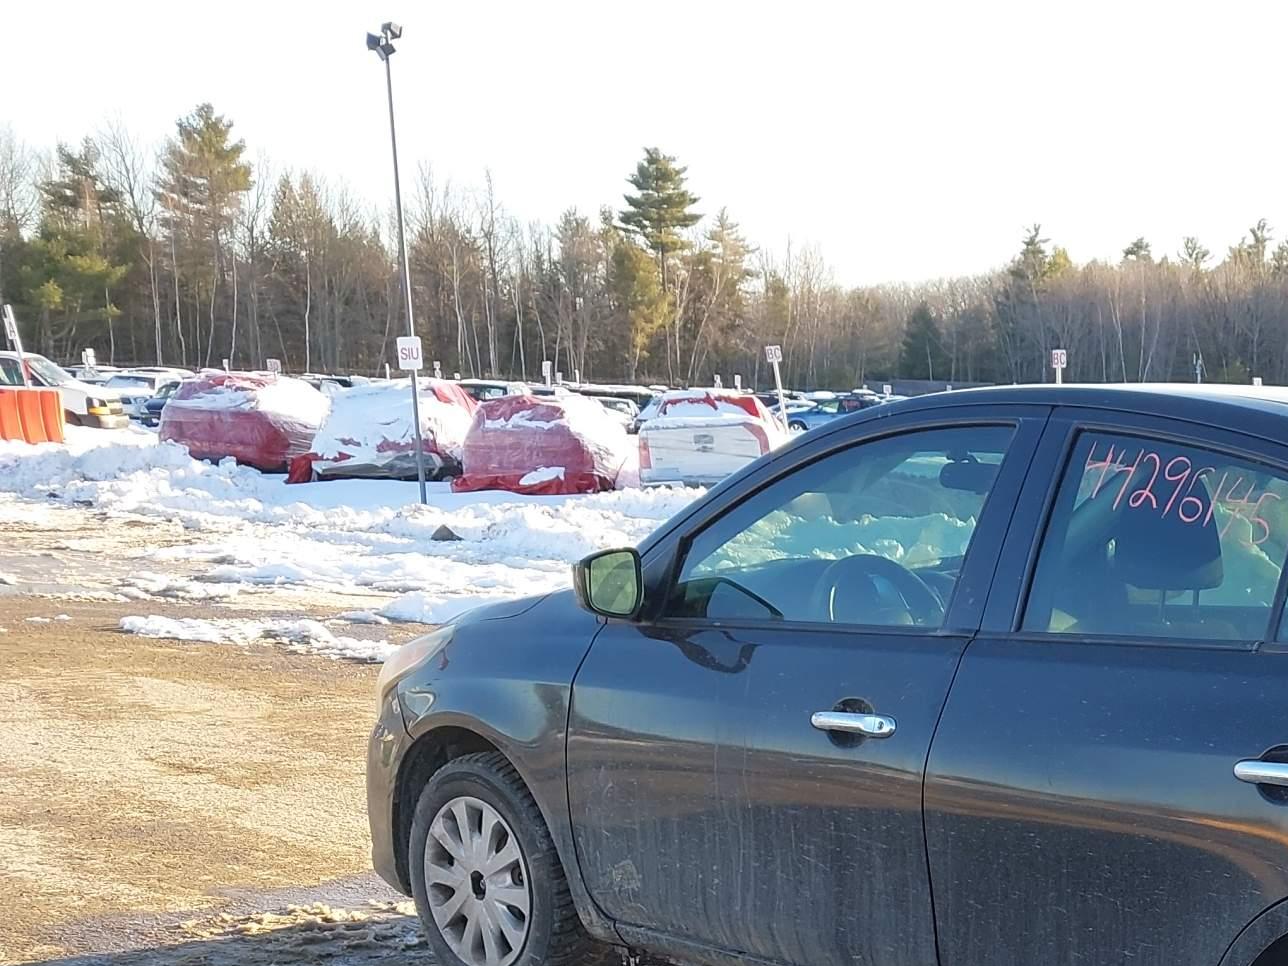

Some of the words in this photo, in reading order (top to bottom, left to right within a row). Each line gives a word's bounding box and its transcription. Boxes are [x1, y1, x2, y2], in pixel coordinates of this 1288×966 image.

[400, 347, 419, 361] SIU
[1053, 352, 1066, 366] BC
[1085, 440, 1281, 545] 44296145
